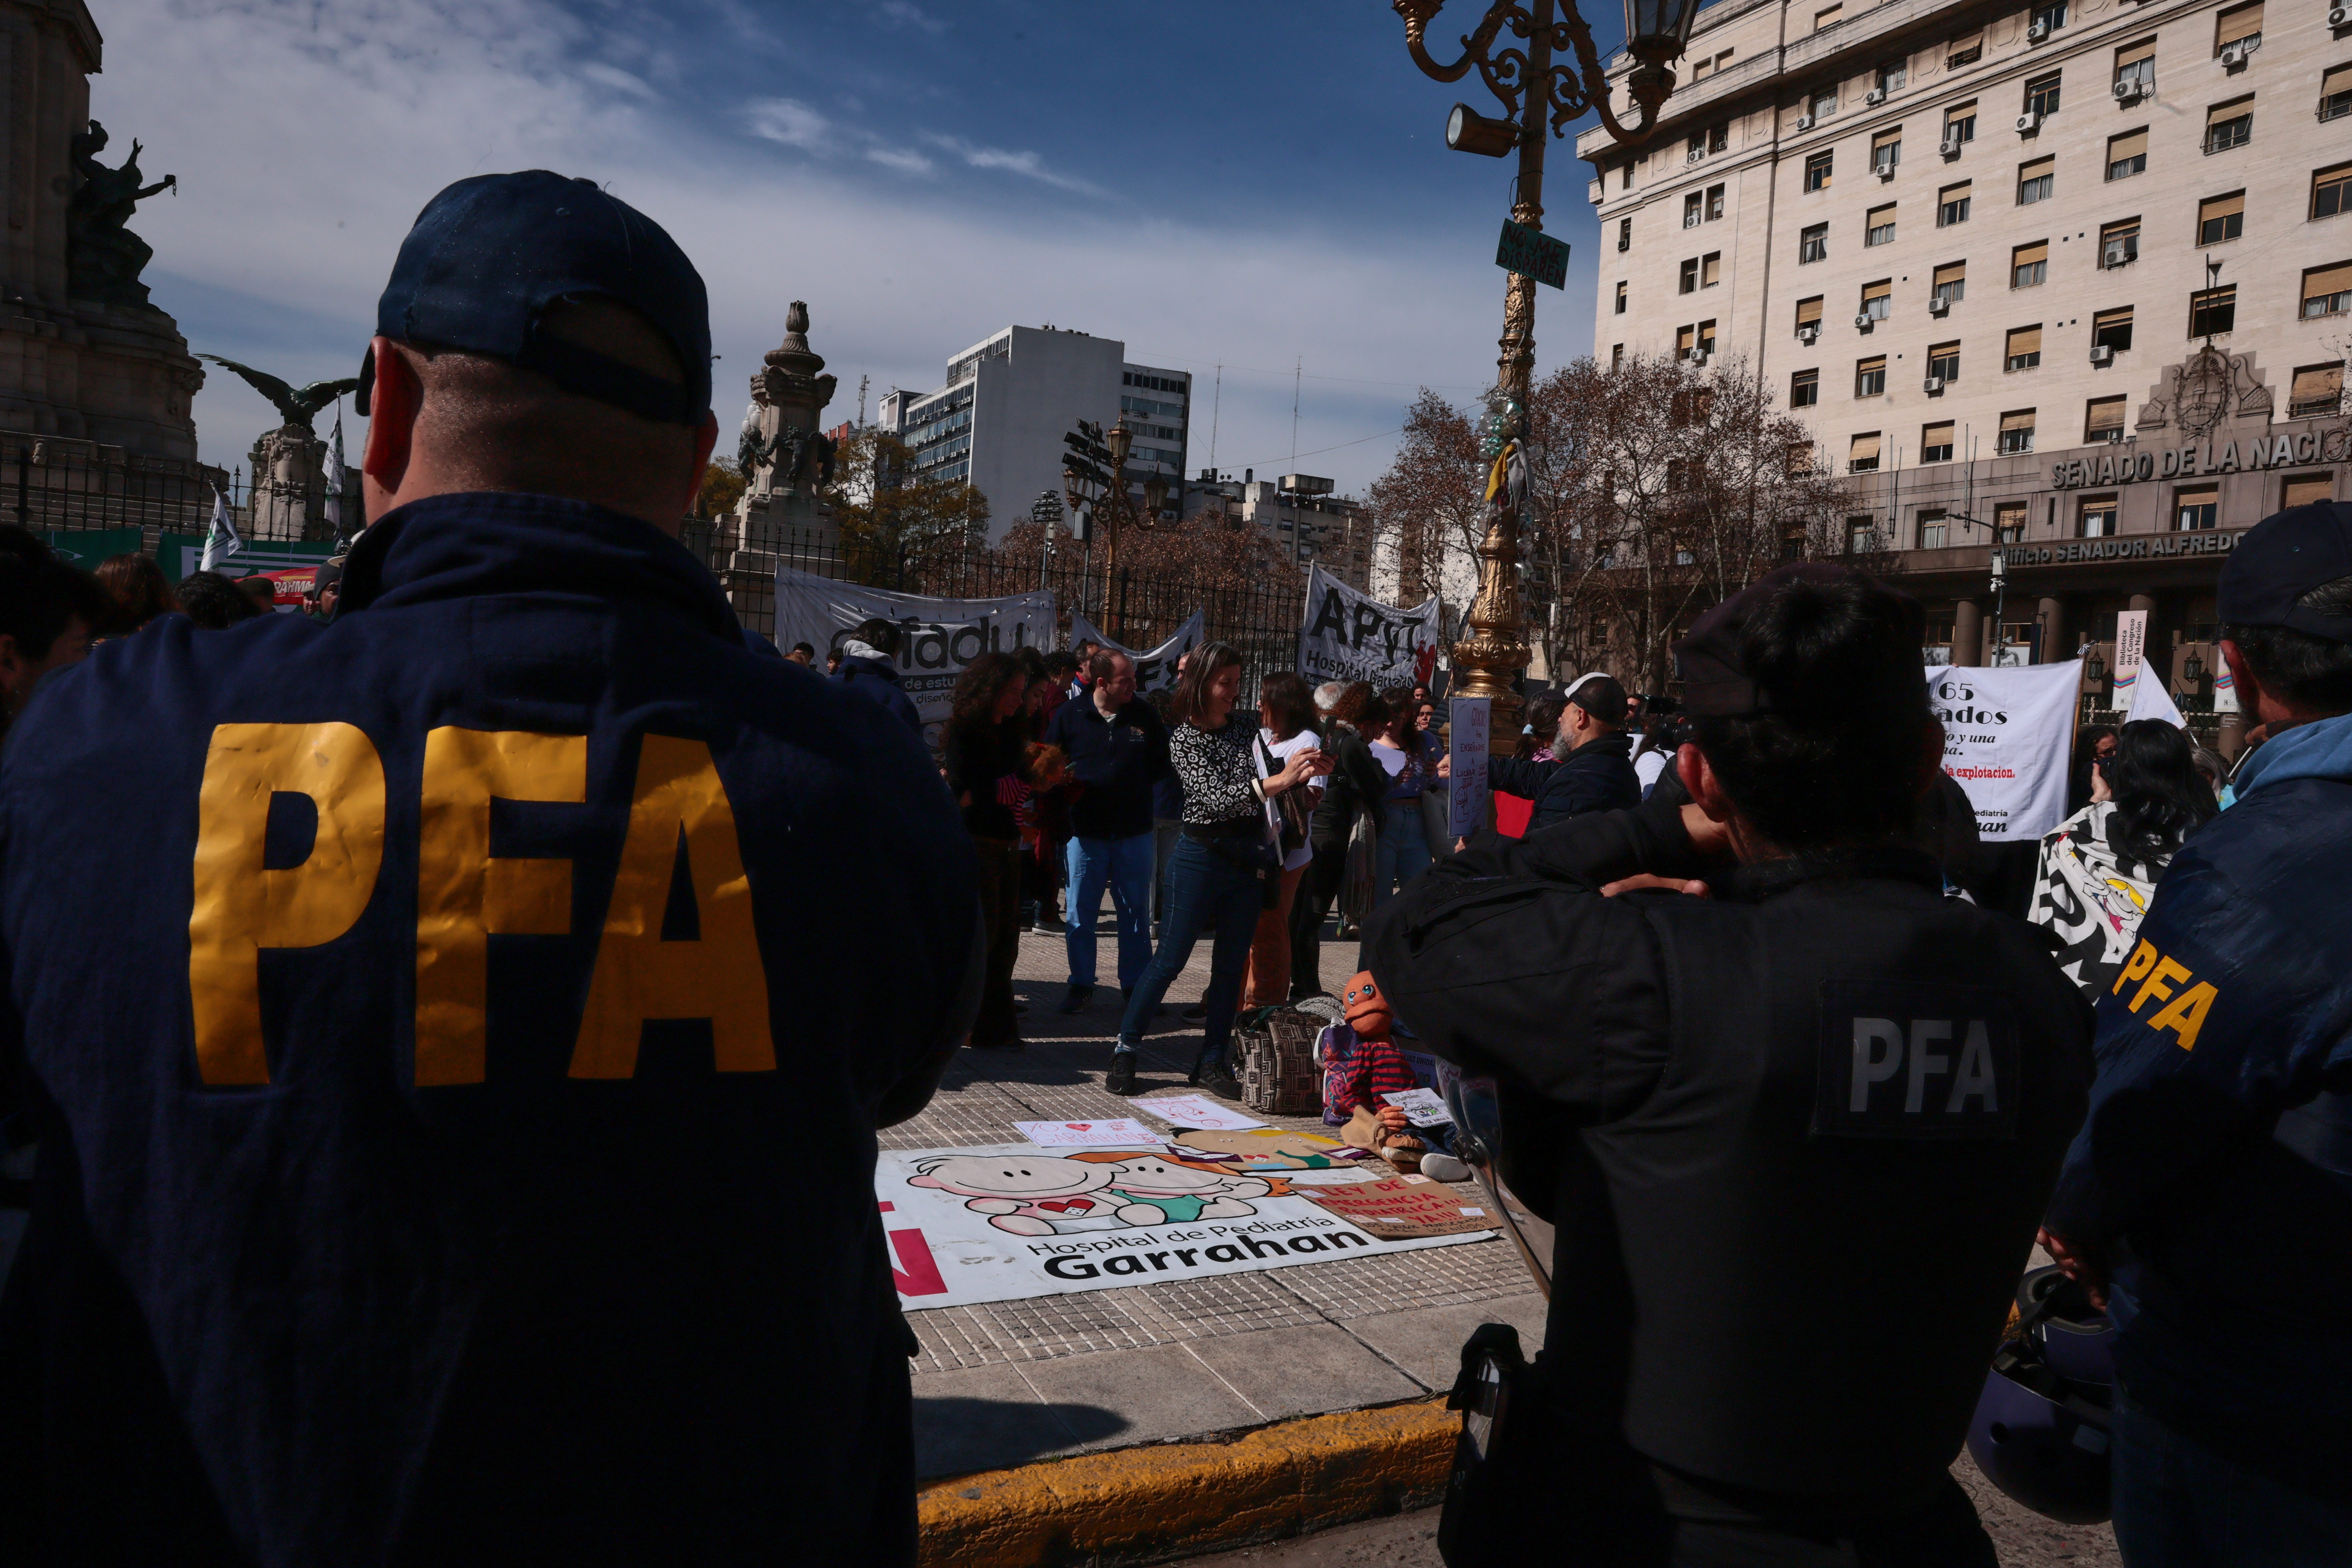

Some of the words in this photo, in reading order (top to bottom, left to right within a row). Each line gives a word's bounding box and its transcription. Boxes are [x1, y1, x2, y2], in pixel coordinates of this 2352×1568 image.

[1504, 225, 1526, 248] NO
[2051, 452, 2152, 488] SENADO
[2160, 446, 2196, 478] DE
[2202, 441, 2240, 472] LA
[2056, 539, 2147, 563] SENADOR
[1306, 650, 1366, 681] Hospital
[2134, 657, 2140, 665] de
[905, 677, 922, 690] de
[1956, 734, 1965, 744] y
[1956, 766, 2015, 780] explotacion.
[189, 721, 777, 1087] PFA
[2112, 937, 2219, 1052] PFA
[1850, 1017, 1998, 1112] PFA
[1019, 1123, 1059, 1132] YO
[1034, 1132, 1144, 1145] GARRAHAN
[1374, 1179, 1407, 1192] DE
[1316, 1192, 1440, 1207] EMERGENCIA
[1026, 1232, 1160, 1255] Hospital
[1167, 1230, 1204, 1242] de
[1209, 1217, 1336, 1237] Pediatría
[1044, 1231, 1370, 1280] Garrahan
